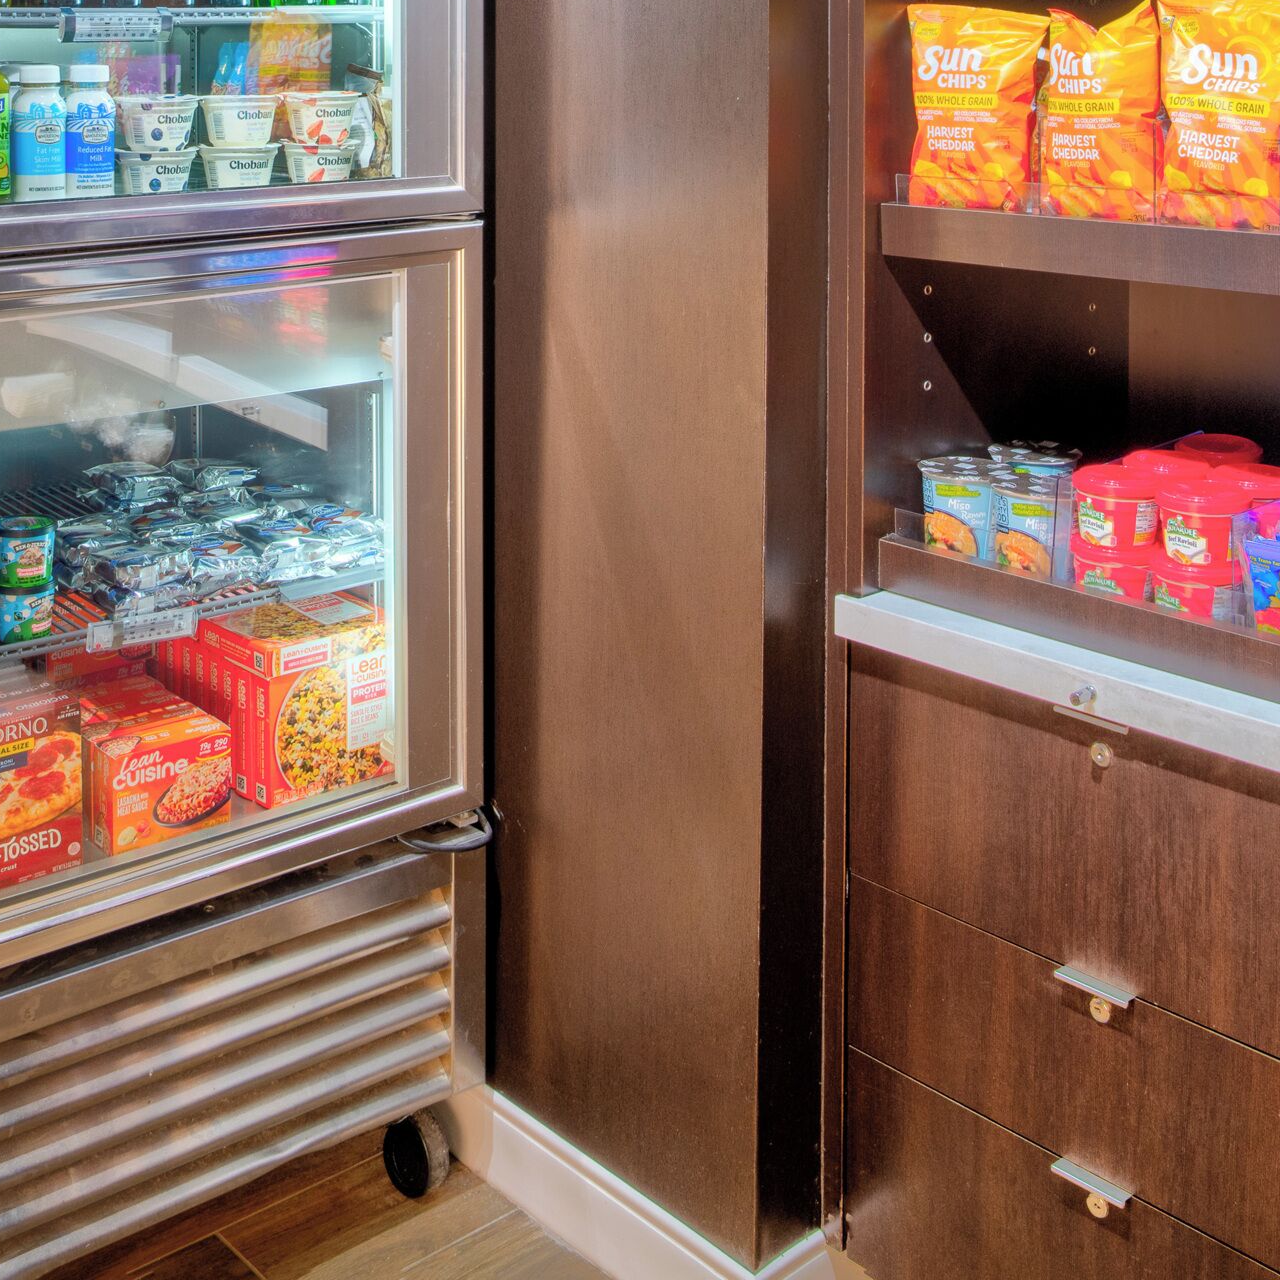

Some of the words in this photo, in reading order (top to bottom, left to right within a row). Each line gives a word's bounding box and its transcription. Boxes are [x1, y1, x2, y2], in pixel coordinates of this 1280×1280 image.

[918, 45, 982, 81] Sun
[1181, 43, 1257, 84] Sun
[937, 74, 987, 89] CHIPS
[1057, 78, 1102, 94] CHIPS
[1203, 77, 1260, 94] CHIPS
[936, 95, 966, 106] WHOLE
[968, 96, 993, 106] GRAIN
[1058, 103, 1083, 112] WHOLE
[1084, 102, 1115, 112] GRAIN
[1169, 96, 1194, 107] 100%
[1197, 98, 1233, 111] WHOLE
[1235, 102, 1265, 115] GRAIN
[927, 125, 974, 139] HARVEST
[1178, 129, 1240, 149] HARVEST
[928, 139, 975, 152] CHEDDAR
[1052, 133, 1096, 147] HARVEST
[89, 154, 103, 162] Milk
[1052, 147, 1100, 160] CHEDDAR
[1178, 144, 1239, 164] CHEDDAR
[229, 159, 269, 170] Chobani
[948, 498, 971, 512] Miso
[11, 741, 30, 753] SIZE
